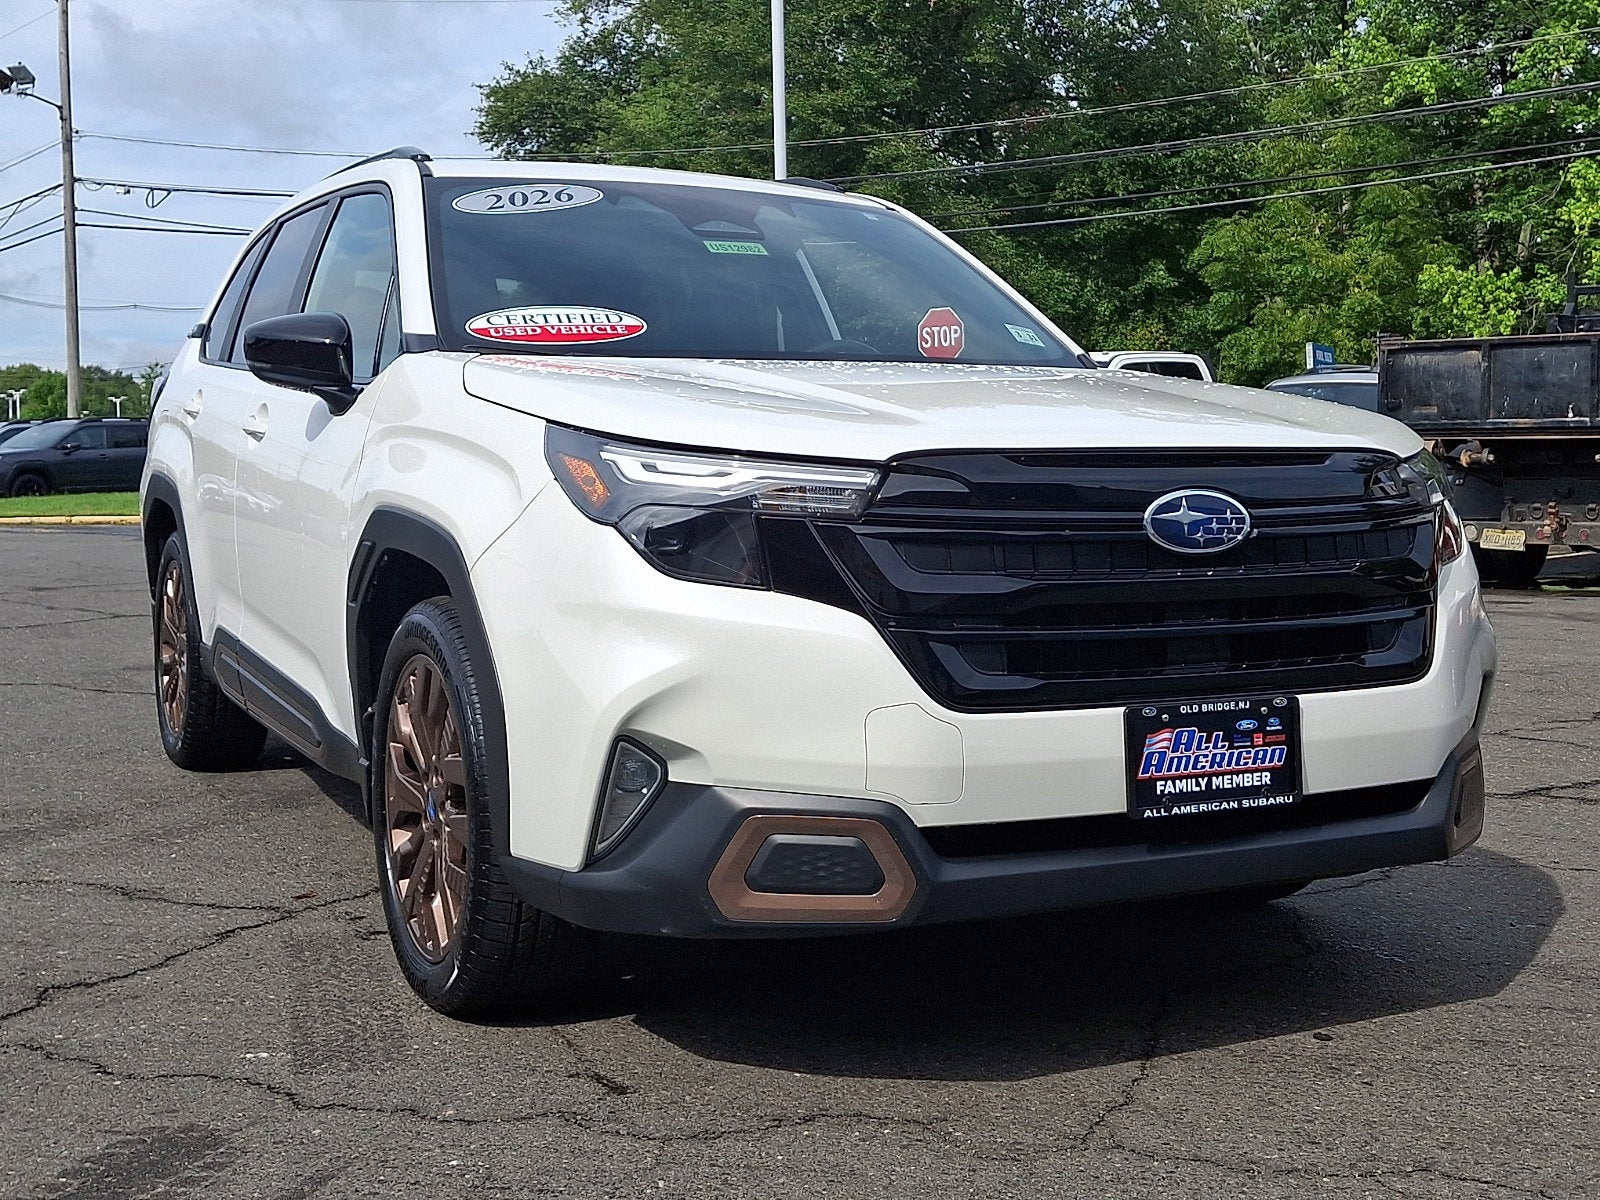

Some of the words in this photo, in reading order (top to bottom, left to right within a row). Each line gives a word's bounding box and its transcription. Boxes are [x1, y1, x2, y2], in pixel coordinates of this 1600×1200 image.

[484, 187, 575, 210] 2026
[486, 312, 623, 326] CERTIFIED
[487, 326, 542, 337] USED
[544, 325, 628, 335] VEHICLE
[921, 325, 961, 348] STOP
[1180, 704, 1199, 714] OLD
[1170, 727, 1229, 753] ALL
[1139, 746, 1287, 777] AMERICAN
[1156, 776, 1209, 795] FAMILY
[1212, 772, 1271, 790] MEMBER
[1143, 807, 1169, 818] ALL
[1171, 800, 1238, 815] AMERICAN
[1242, 795, 1293, 808] SUBARU
